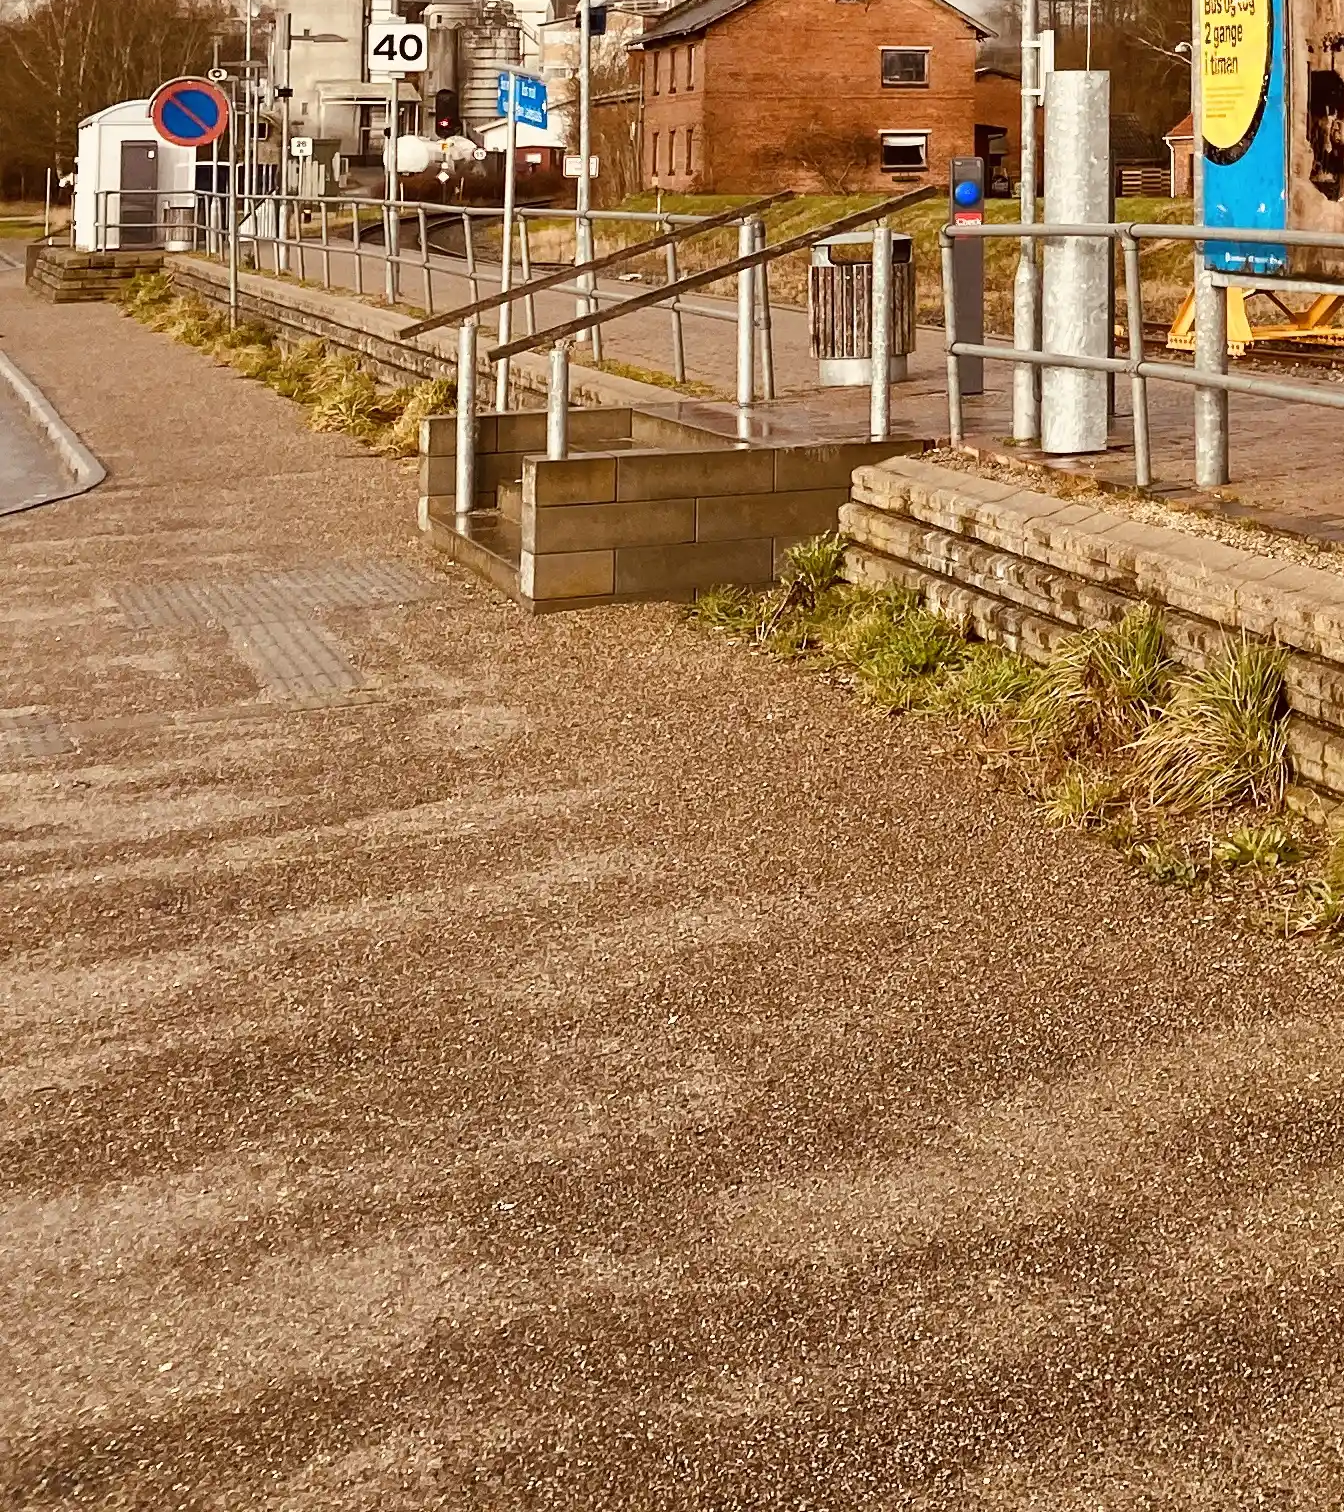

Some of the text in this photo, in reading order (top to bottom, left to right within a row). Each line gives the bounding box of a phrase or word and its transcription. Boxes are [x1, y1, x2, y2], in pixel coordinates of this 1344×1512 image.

[373, 34, 423, 61] 40
[1204, 21, 1243, 48] 2 gange
[1210, 51, 1239, 76] timen
